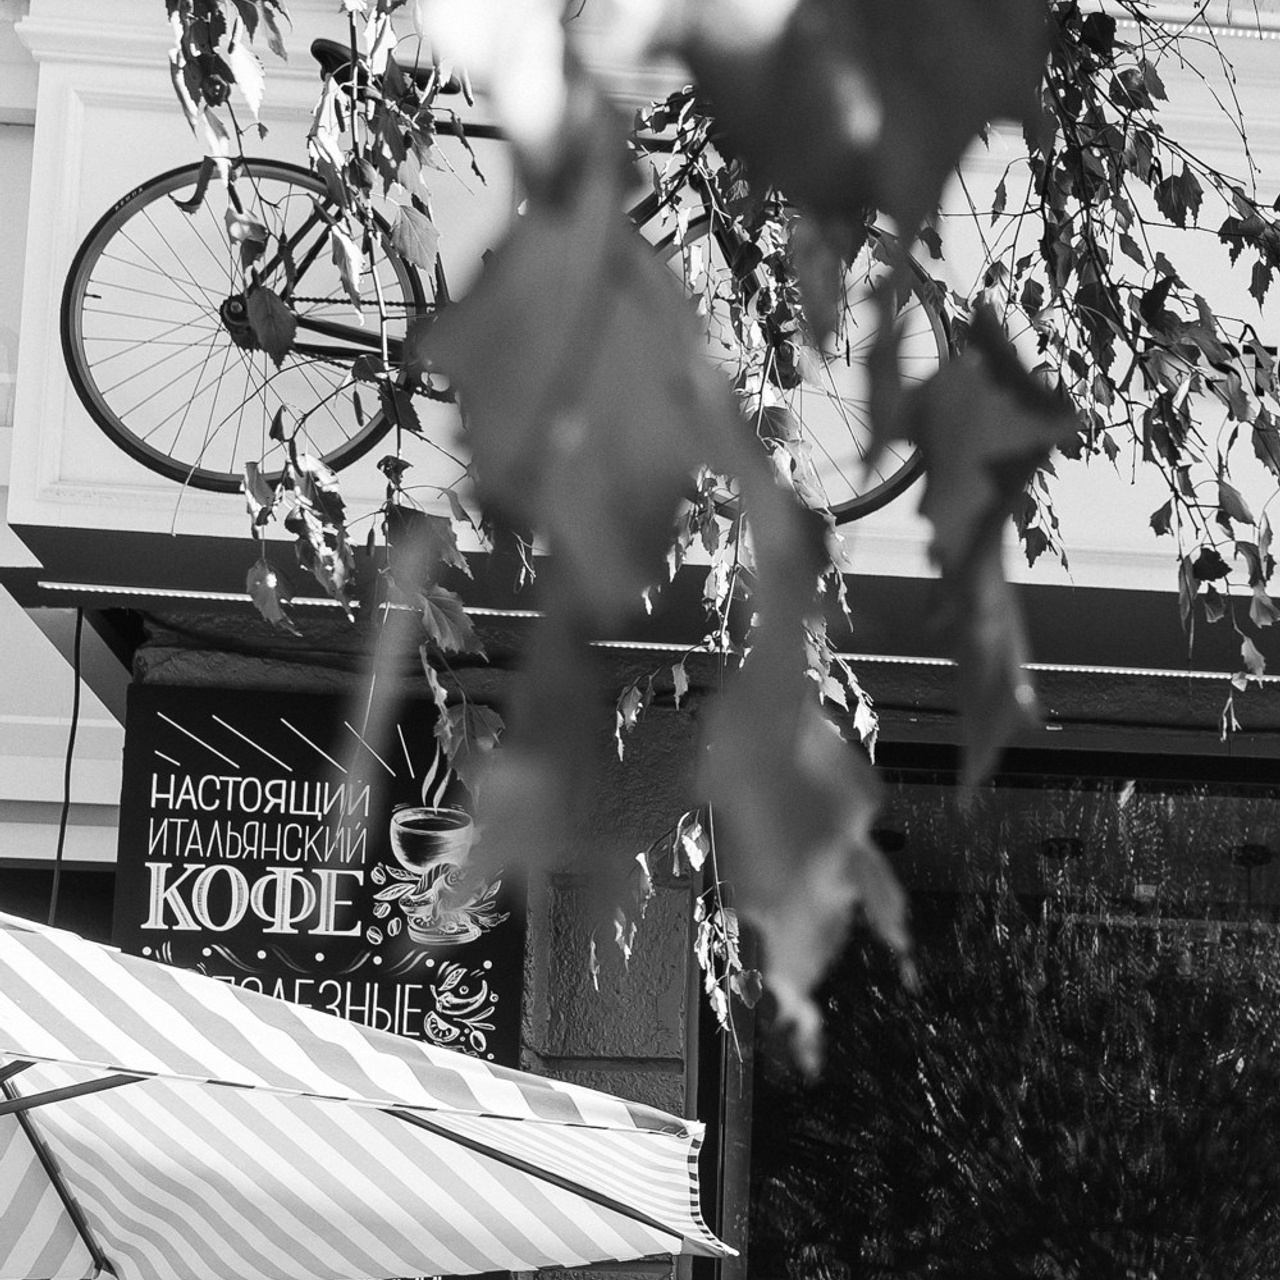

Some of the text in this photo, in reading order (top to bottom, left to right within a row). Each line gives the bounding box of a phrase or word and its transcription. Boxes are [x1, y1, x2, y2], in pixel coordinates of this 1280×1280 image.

[151, 773, 370, 821] НАСТОЯЩИЙ
[149, 818, 367, 864] ИТАЛЬЯНСКИЙ
[141, 862, 364, 936] КОФЕ
[213, 976, 423, 1036] ЕЗНЫЕ
